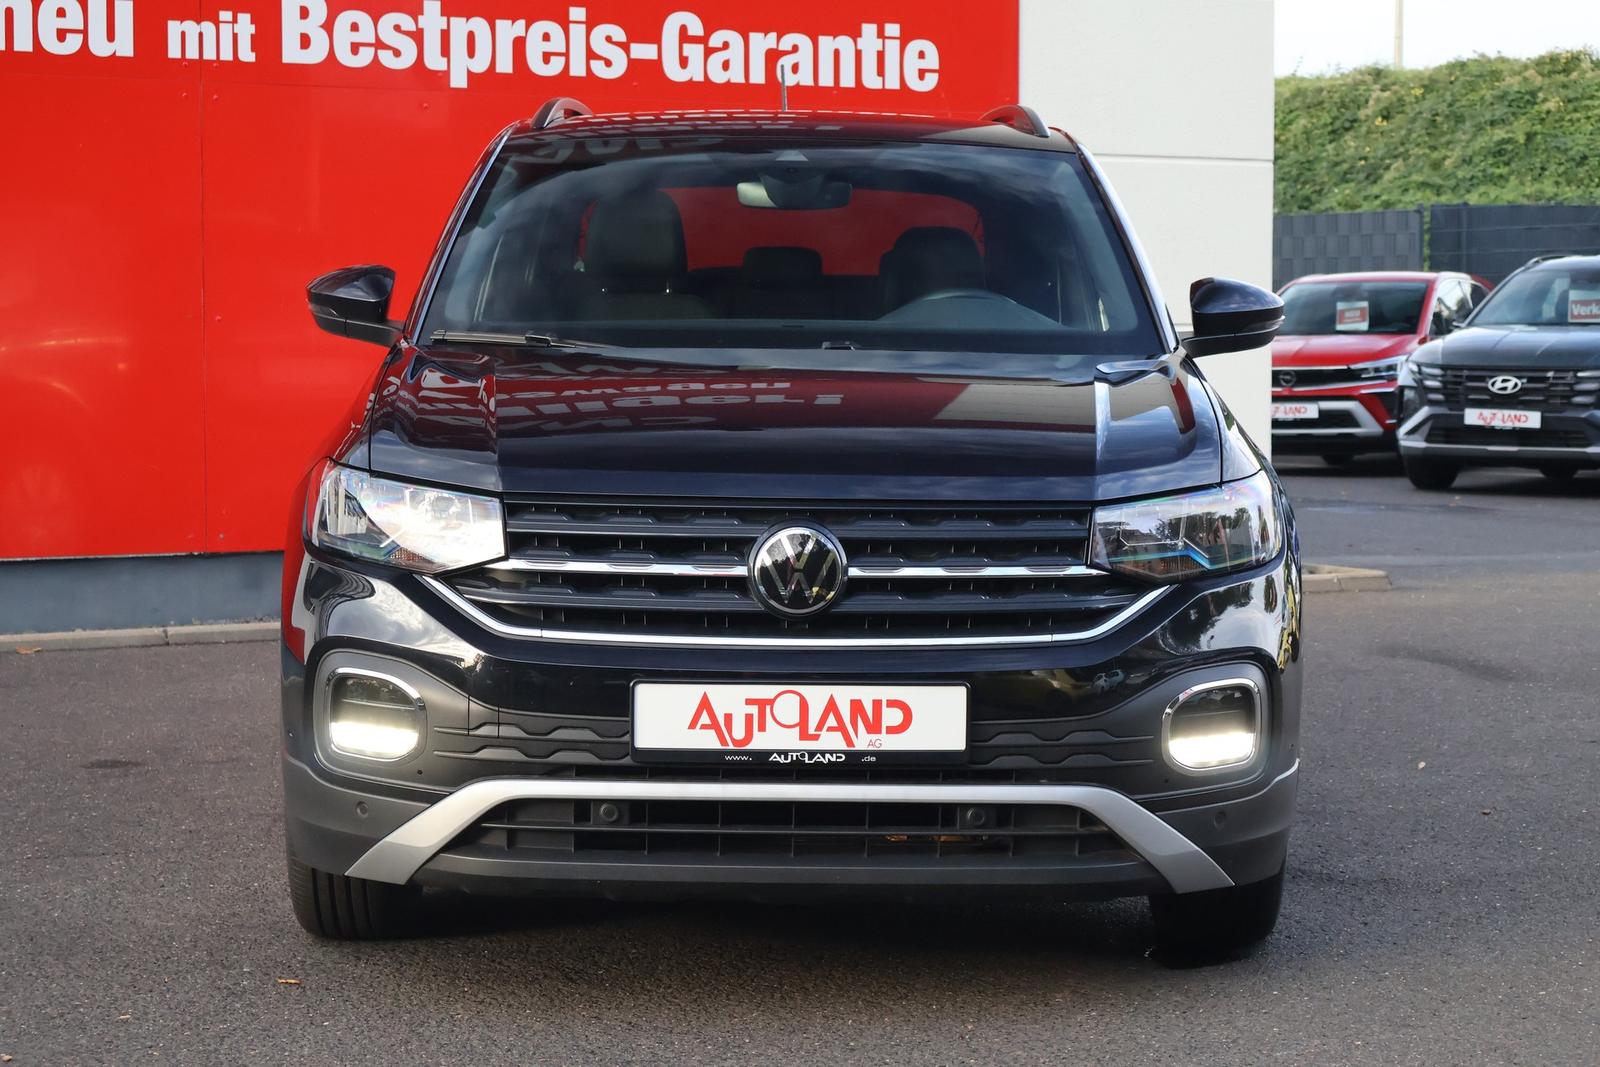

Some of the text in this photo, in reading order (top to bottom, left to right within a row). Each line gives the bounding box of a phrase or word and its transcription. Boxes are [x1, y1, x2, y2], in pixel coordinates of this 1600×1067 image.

[0, 0, 940, 92] neu mit Bestpreis-Garantie
[687, 689, 913, 748] AUTOLAND
[768, 751, 846, 764] AUTOLAND
[867, 738, 883, 748] AG
